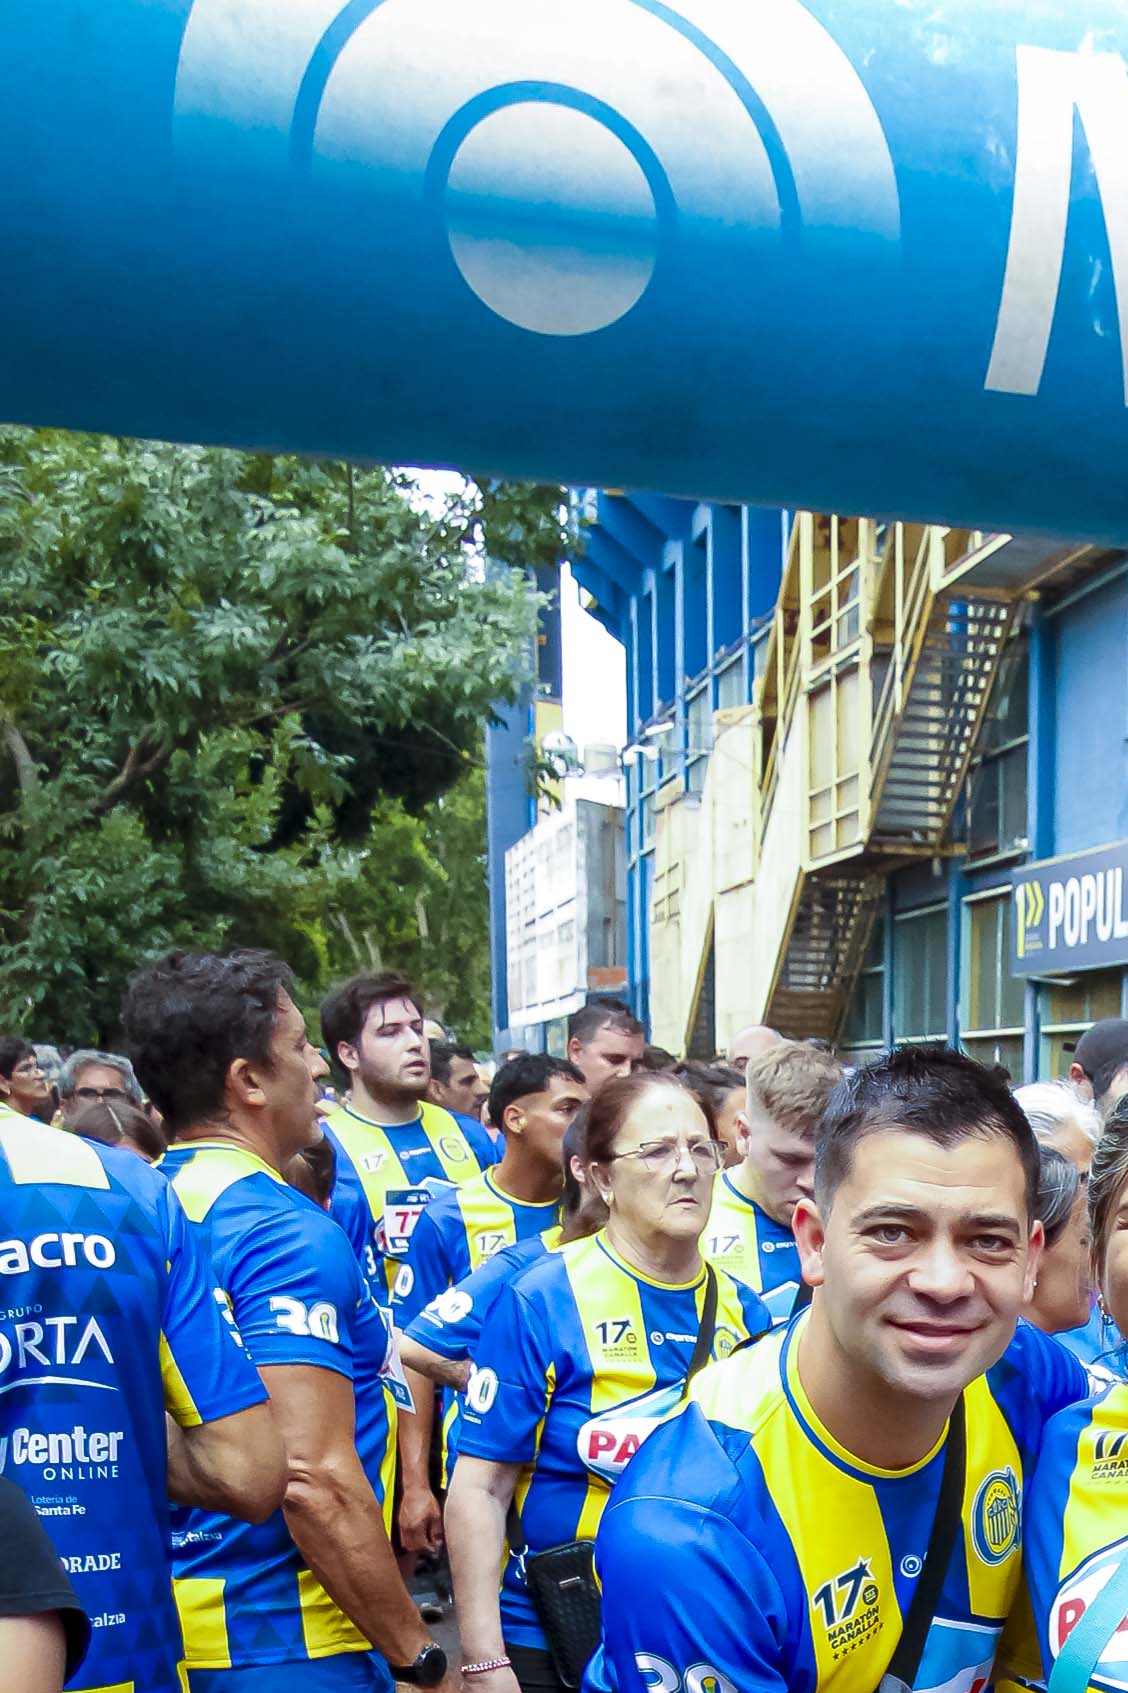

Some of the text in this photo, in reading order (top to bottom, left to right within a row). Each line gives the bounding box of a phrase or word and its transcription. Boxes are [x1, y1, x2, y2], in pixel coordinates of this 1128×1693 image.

[0, 1303, 43, 1321] GRUPO
[596, 1319, 632, 1345] 17
[13, 1426, 124, 1465] Center
[43, 1465, 119, 1481] ONLINE
[72, 1504, 86, 1515] Fe
[811, 1555, 876, 1632] 17
[827, 1605, 880, 1642] MARATÓN
[831, 1615, 880, 1650] CANALLA
